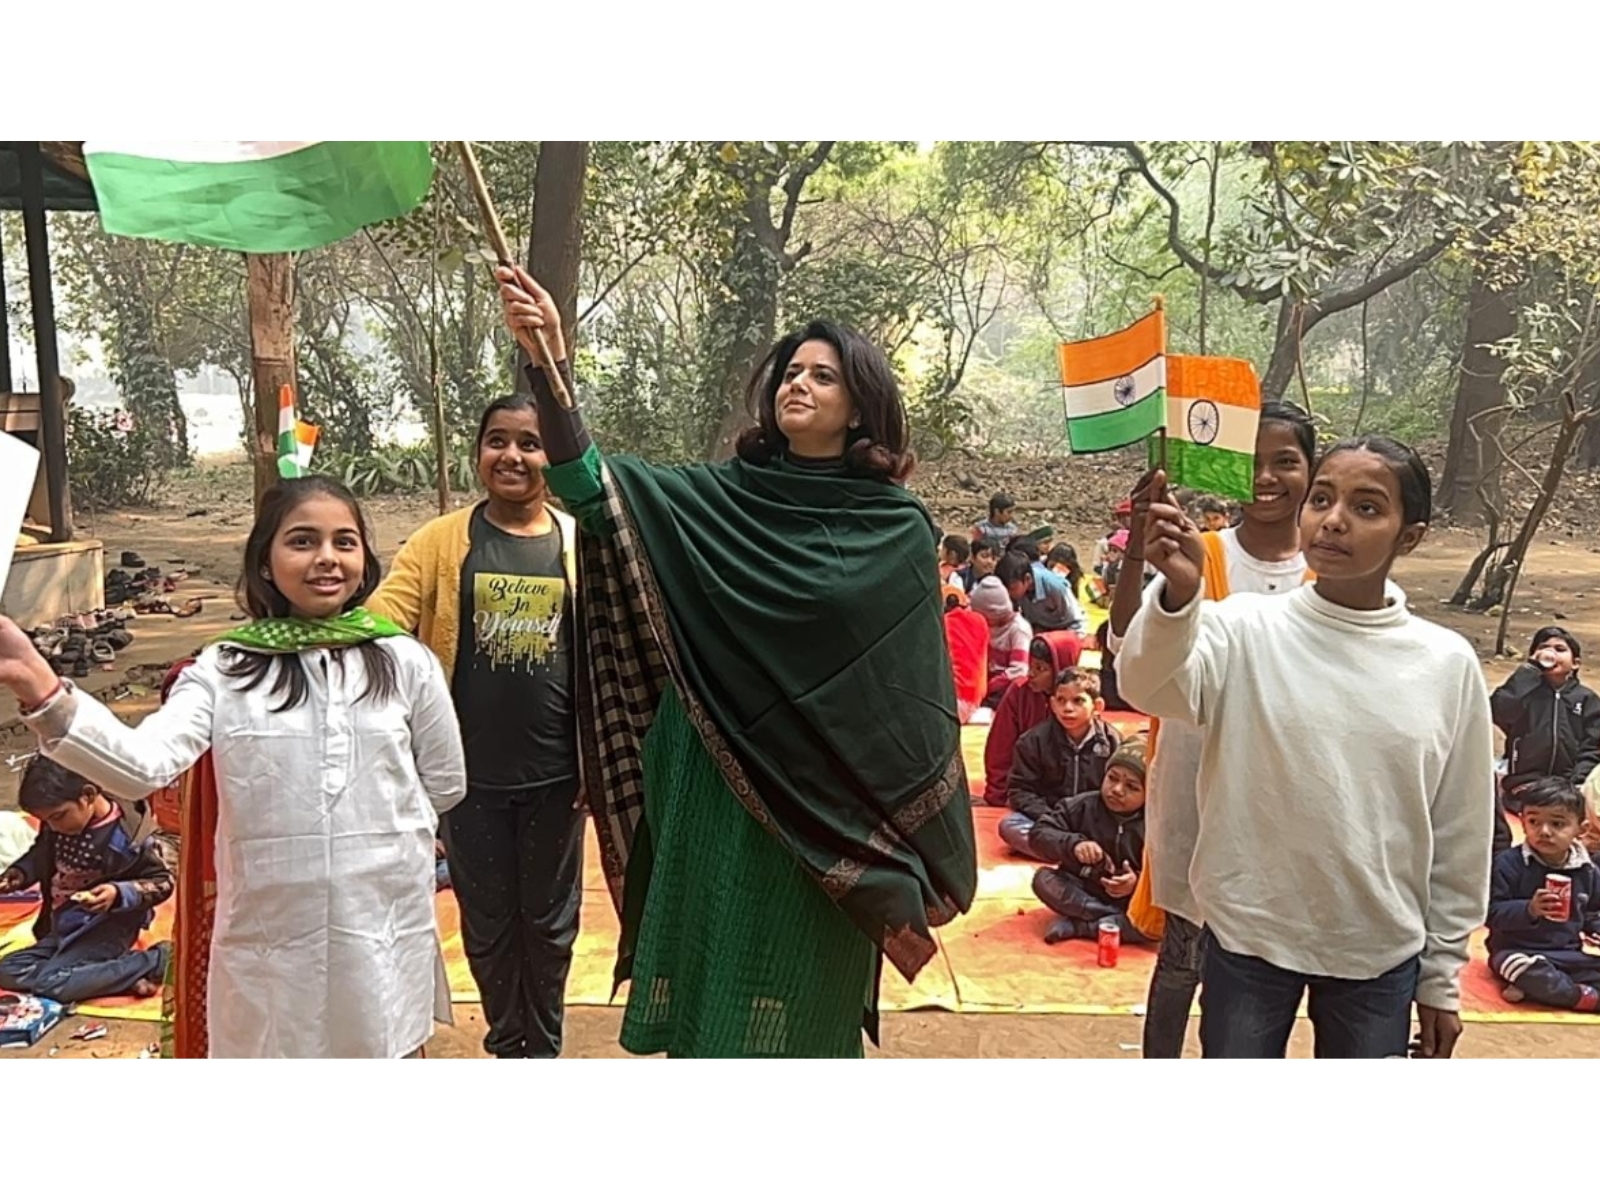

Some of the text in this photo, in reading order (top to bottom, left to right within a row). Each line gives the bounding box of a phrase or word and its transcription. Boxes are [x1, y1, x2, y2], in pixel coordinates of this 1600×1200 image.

[489, 577, 549, 601] Believe
[508, 596, 531, 617] In
[473, 609, 563, 641] Yourself
